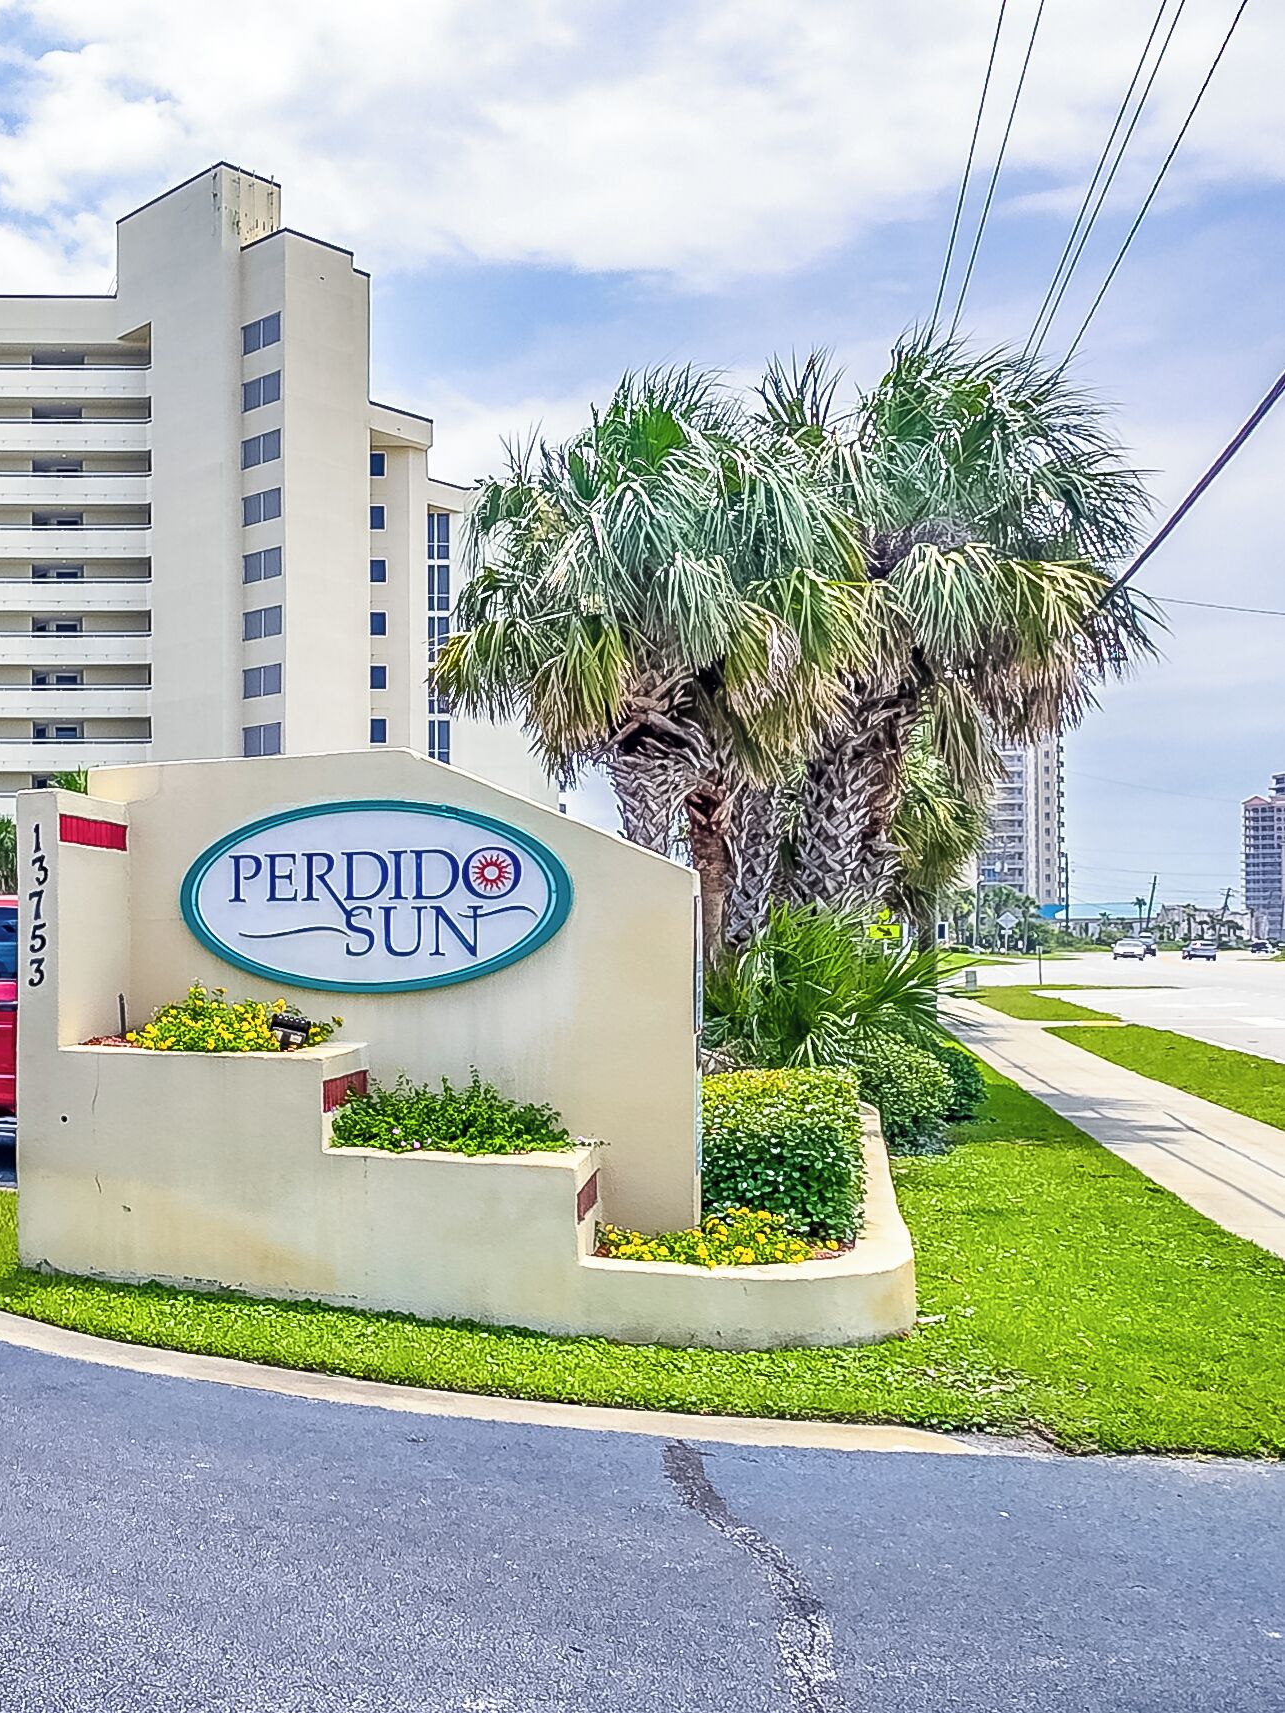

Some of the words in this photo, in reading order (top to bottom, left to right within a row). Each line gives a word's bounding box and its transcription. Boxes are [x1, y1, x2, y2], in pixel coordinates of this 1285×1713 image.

[28, 823, 48, 987] 13753
[228, 846, 522, 913] PERDIDO
[345, 905, 484, 957] SUN
